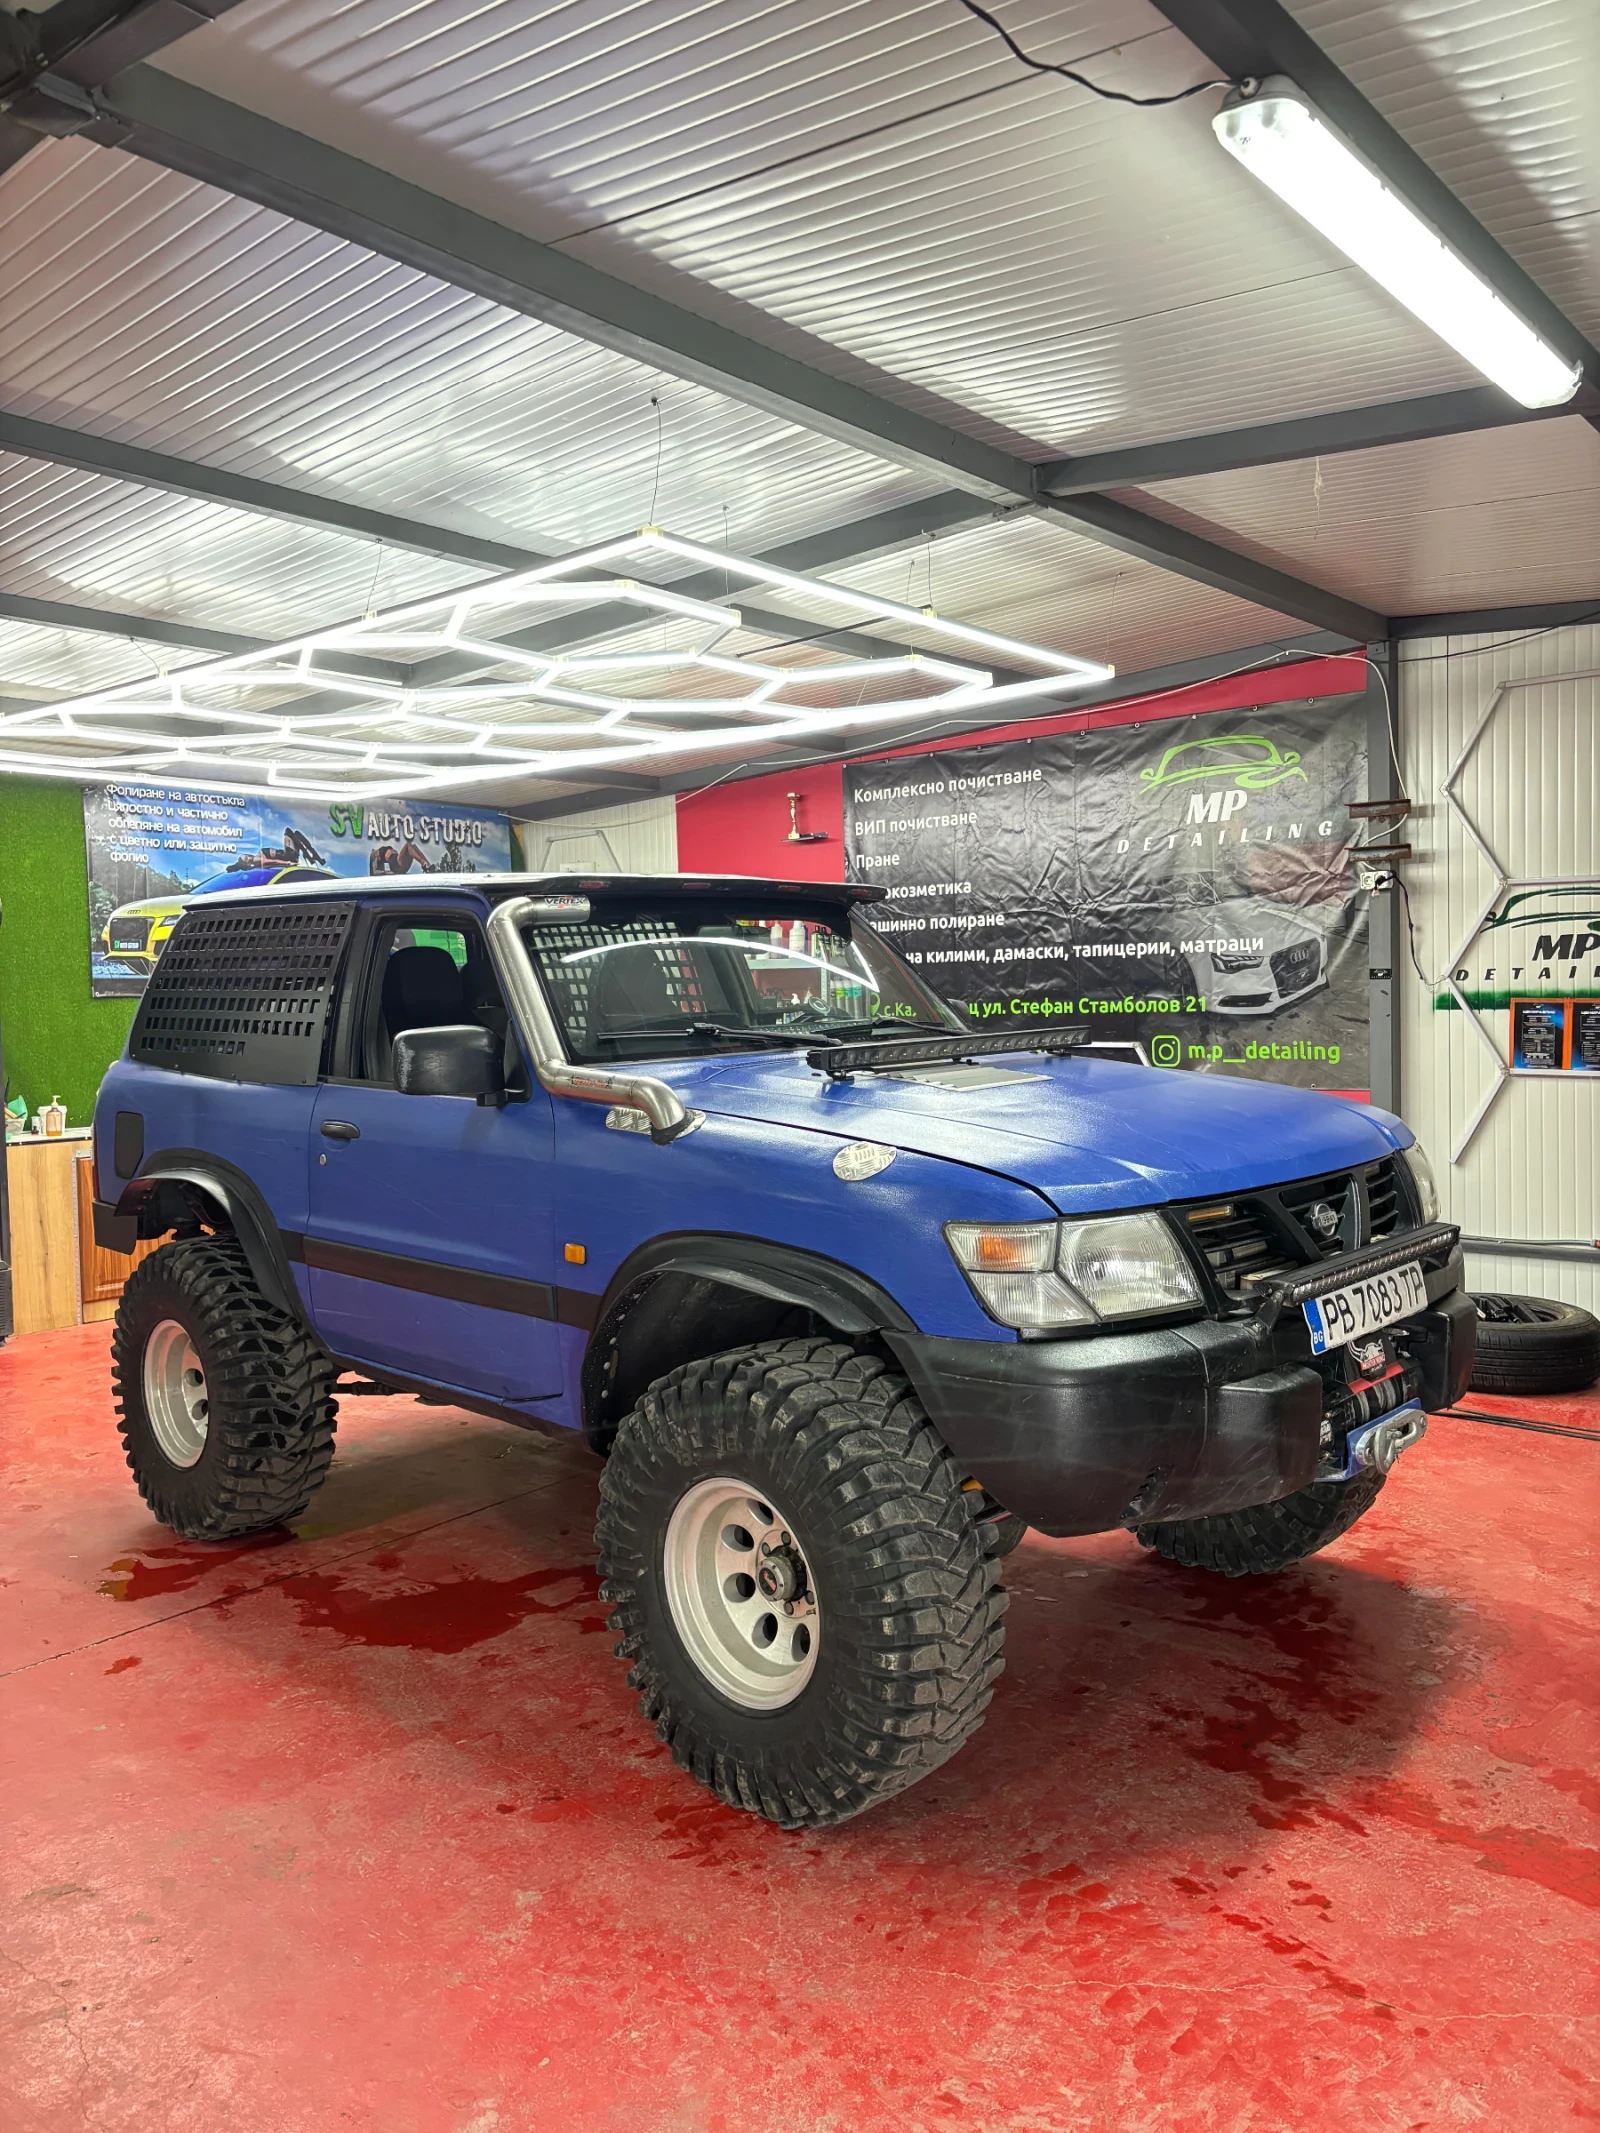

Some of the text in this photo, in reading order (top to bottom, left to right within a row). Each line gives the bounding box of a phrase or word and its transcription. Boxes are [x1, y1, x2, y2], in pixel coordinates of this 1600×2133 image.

[106, 784, 246, 807] Фолиране на автостъкла
[854, 768, 1042, 803] Комплексно почистване
[107, 800, 163, 815] Цялостно
[178, 808, 229, 821] частично
[1186, 789, 1248, 825] MP
[108, 817, 243, 838] облепяне на автомобил
[329, 803, 482, 845] SV AUTO STUDIO
[855, 811, 978, 836] ВИП почистване
[120, 836, 161, 848] цветно
[164, 839, 187, 850] или
[189, 841, 237, 853] защитно
[1117, 820, 1333, 854] DETAILING
[110, 850, 149, 863] фолио
[856, 853, 900, 871] Пране
[544, 897, 585, 905] VERTEX
[869, 914, 1005, 932] ашинно полиране
[926, 949, 990, 964] килими,
[993, 944, 1069, 963] дамаски,
[1073, 939, 1175, 959] тапицерии,
[1180, 936, 1264, 954] матраци
[1532, 933, 1600, 961] MP
[982, 1002, 1006, 1018] ул.
[1010, 997, 1073, 1018] Стефан
[1078, 995, 1181, 1014] Стамболов
[1186, 996, 1206, 1013] 21
[1321, 1266, 1424, 1340] PB 7083 TP
[1313, 1330, 1324, 1344] BG
